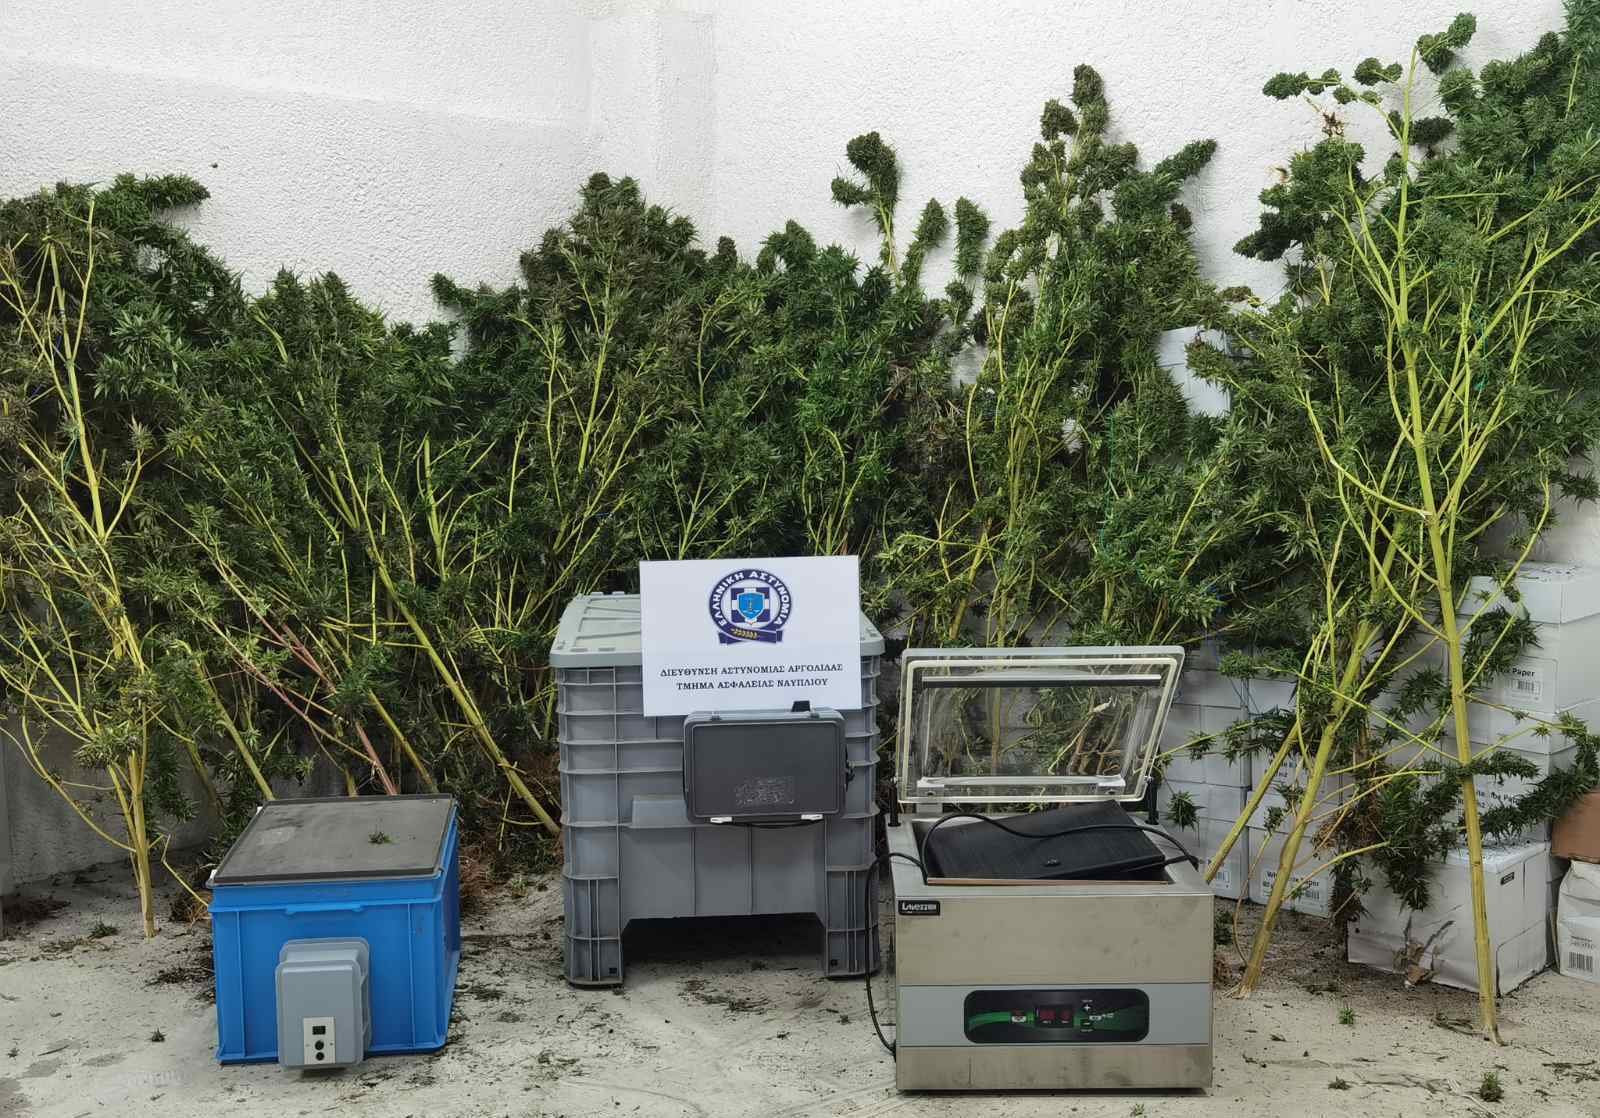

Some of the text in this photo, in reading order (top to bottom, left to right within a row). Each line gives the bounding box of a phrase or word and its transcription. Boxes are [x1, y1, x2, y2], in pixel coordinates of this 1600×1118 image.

[712, 571, 790, 626] ΕΛΛΗΝΙΚΗ ΑΣΤΥΝΟΜΙΑ
[660, 663, 843, 677] ΔΙΕΥΘΥΝΣΗ ΑΣΤΥΝΟΜΙΑΣ ΑΡΓΟΛΙΔΑΣ
[676, 678, 829, 691] ΤΜΗΜΑ ΑΣΦΑΛΕΙΑΣ ΝΑΥΠΛΙΟΥ
